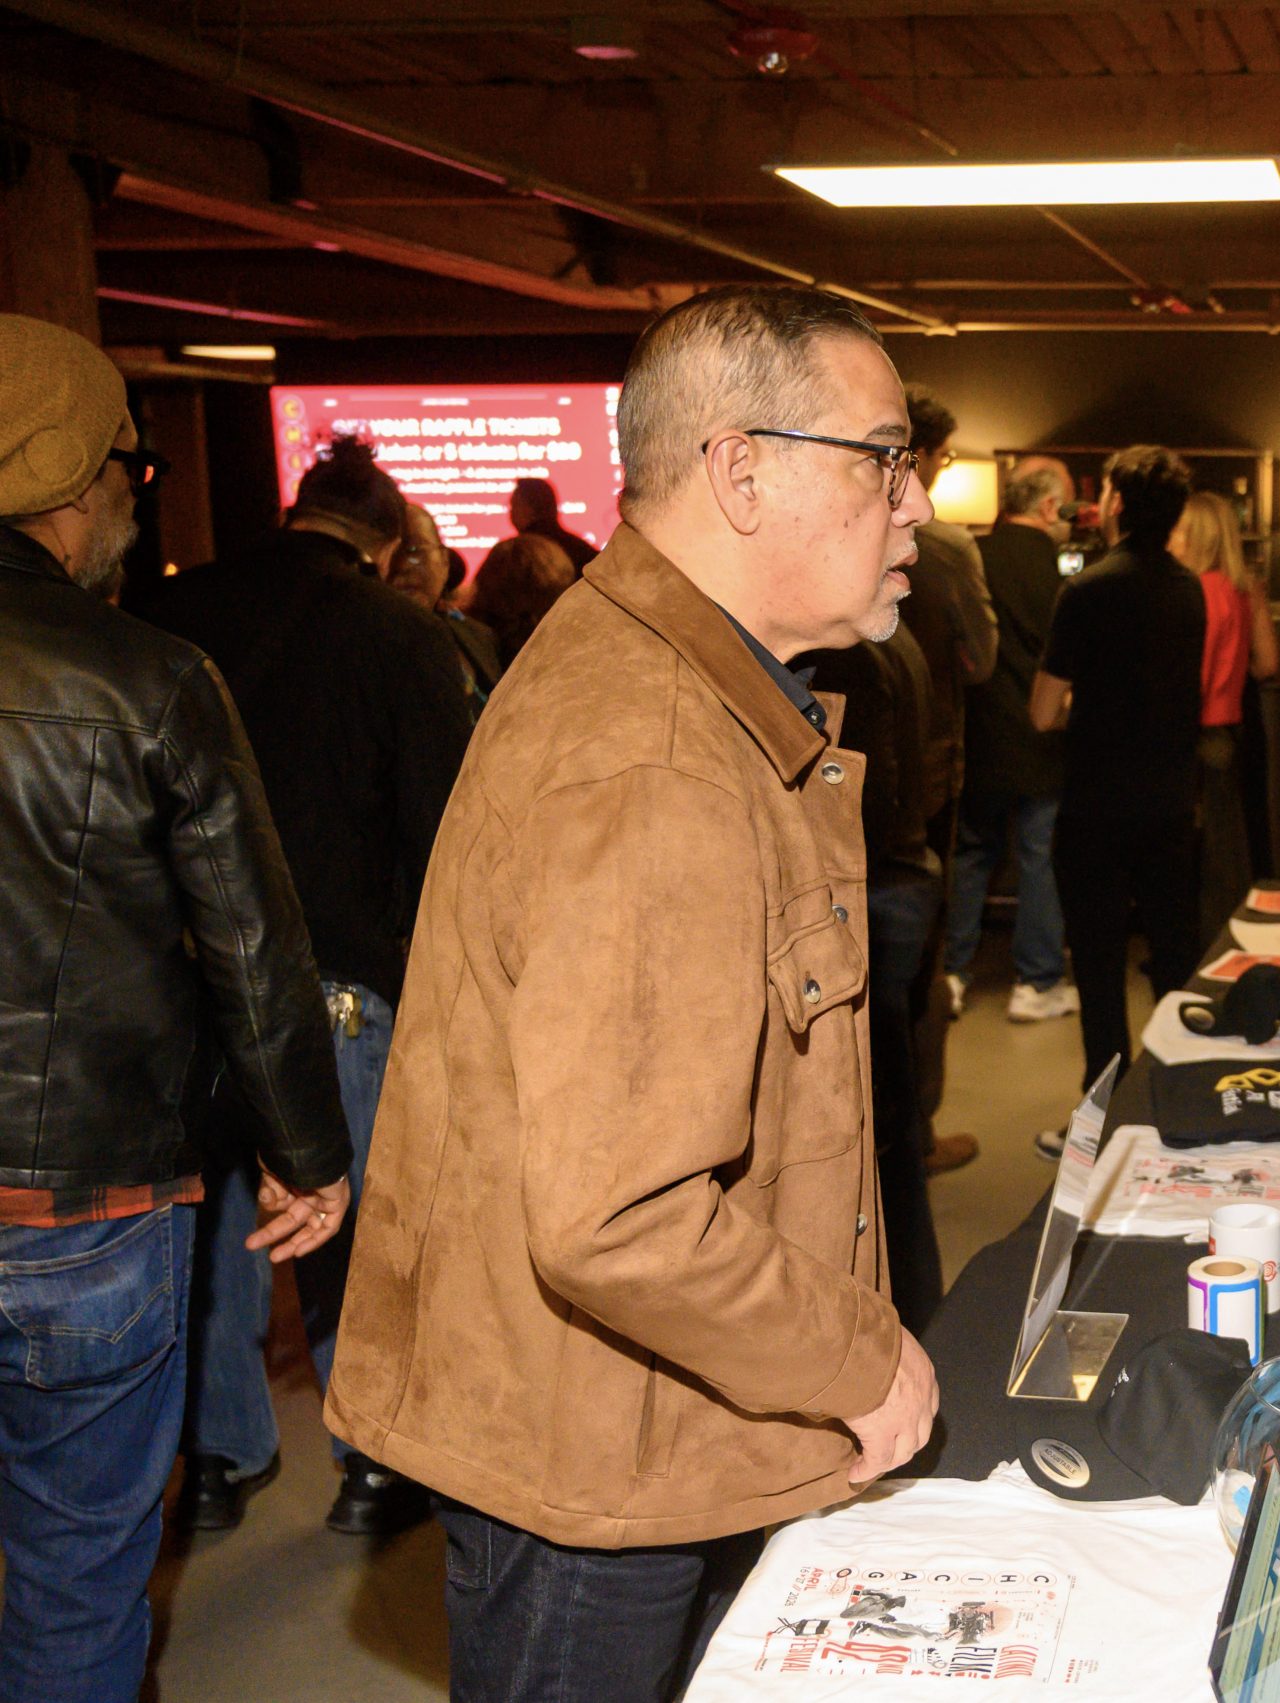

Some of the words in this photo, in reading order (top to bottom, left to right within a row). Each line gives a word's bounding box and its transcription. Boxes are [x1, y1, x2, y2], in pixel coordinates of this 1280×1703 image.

[421, 417, 487, 437] RAFFLE
[488, 416, 561, 436] TICKETS
[803, 1567, 825, 1591] APRIL
[836, 1567, 1050, 1584] CHICAGO
